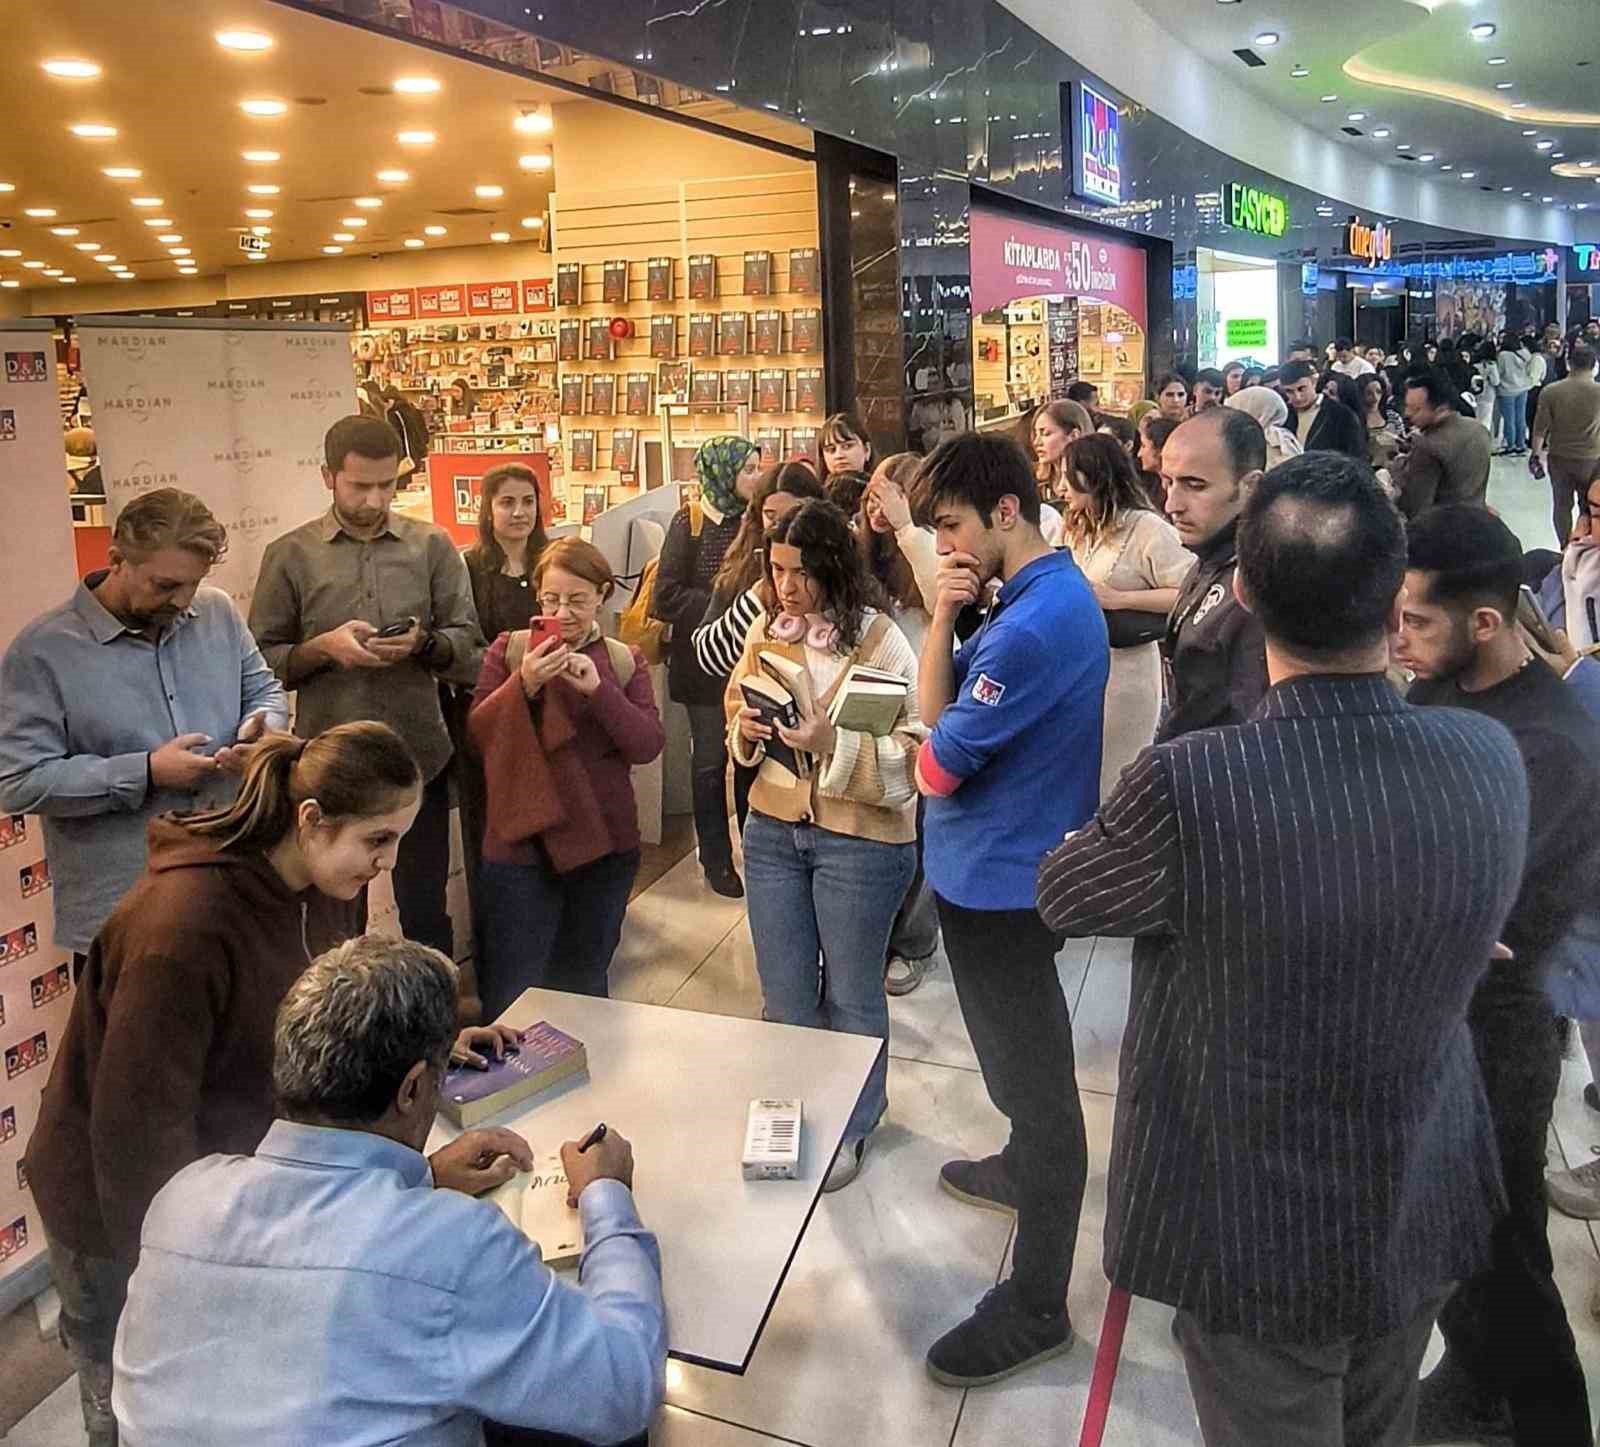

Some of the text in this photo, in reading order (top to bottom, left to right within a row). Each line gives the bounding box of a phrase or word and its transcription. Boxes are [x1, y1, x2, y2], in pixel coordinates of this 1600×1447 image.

[1004, 234, 1061, 272] KİTAPLARDA
[97, 335, 167, 347] MARDIAN
[7, 359, 45, 374] D&R
[207, 380, 265, 389] MARDIAN
[104, 397, 172, 409] MARDIAN
[112, 473, 178, 488] MARDIAN
[33, 971, 68, 999] D&R
[8, 1040, 46, 1070] D&R
